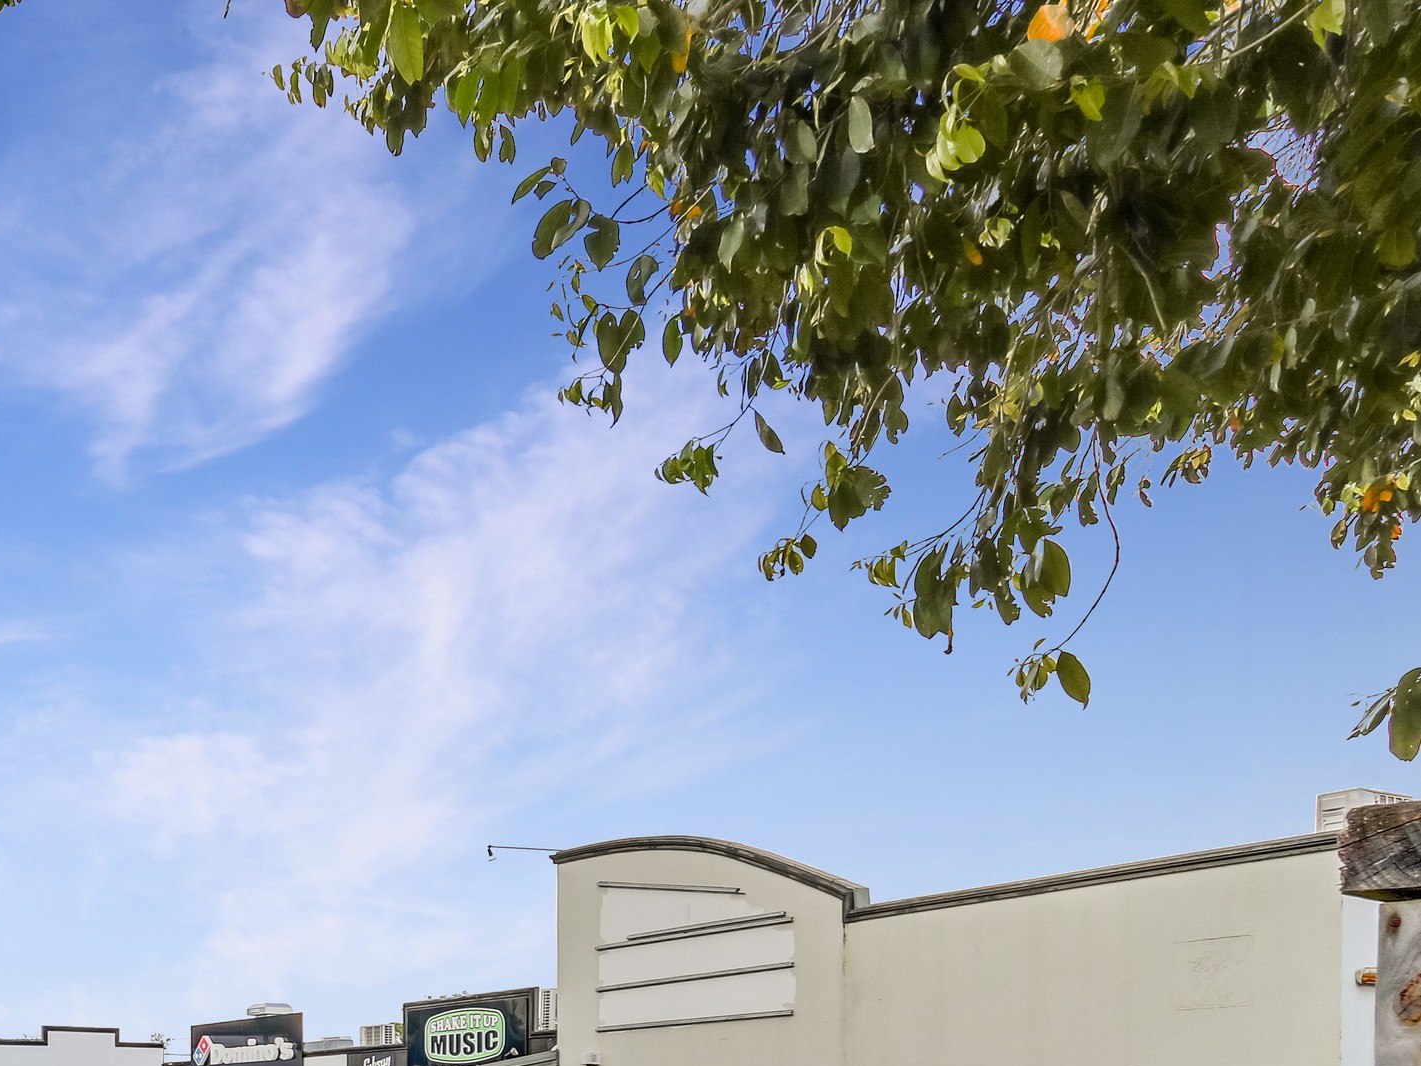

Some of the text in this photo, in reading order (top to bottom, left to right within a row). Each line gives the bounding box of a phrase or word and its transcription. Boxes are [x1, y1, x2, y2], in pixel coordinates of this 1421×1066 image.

[430, 1014, 498, 1032] SHAKE IT UP
[210, 1037, 295, 1065] Domino's
[430, 1029, 499, 1056] MUSIC
